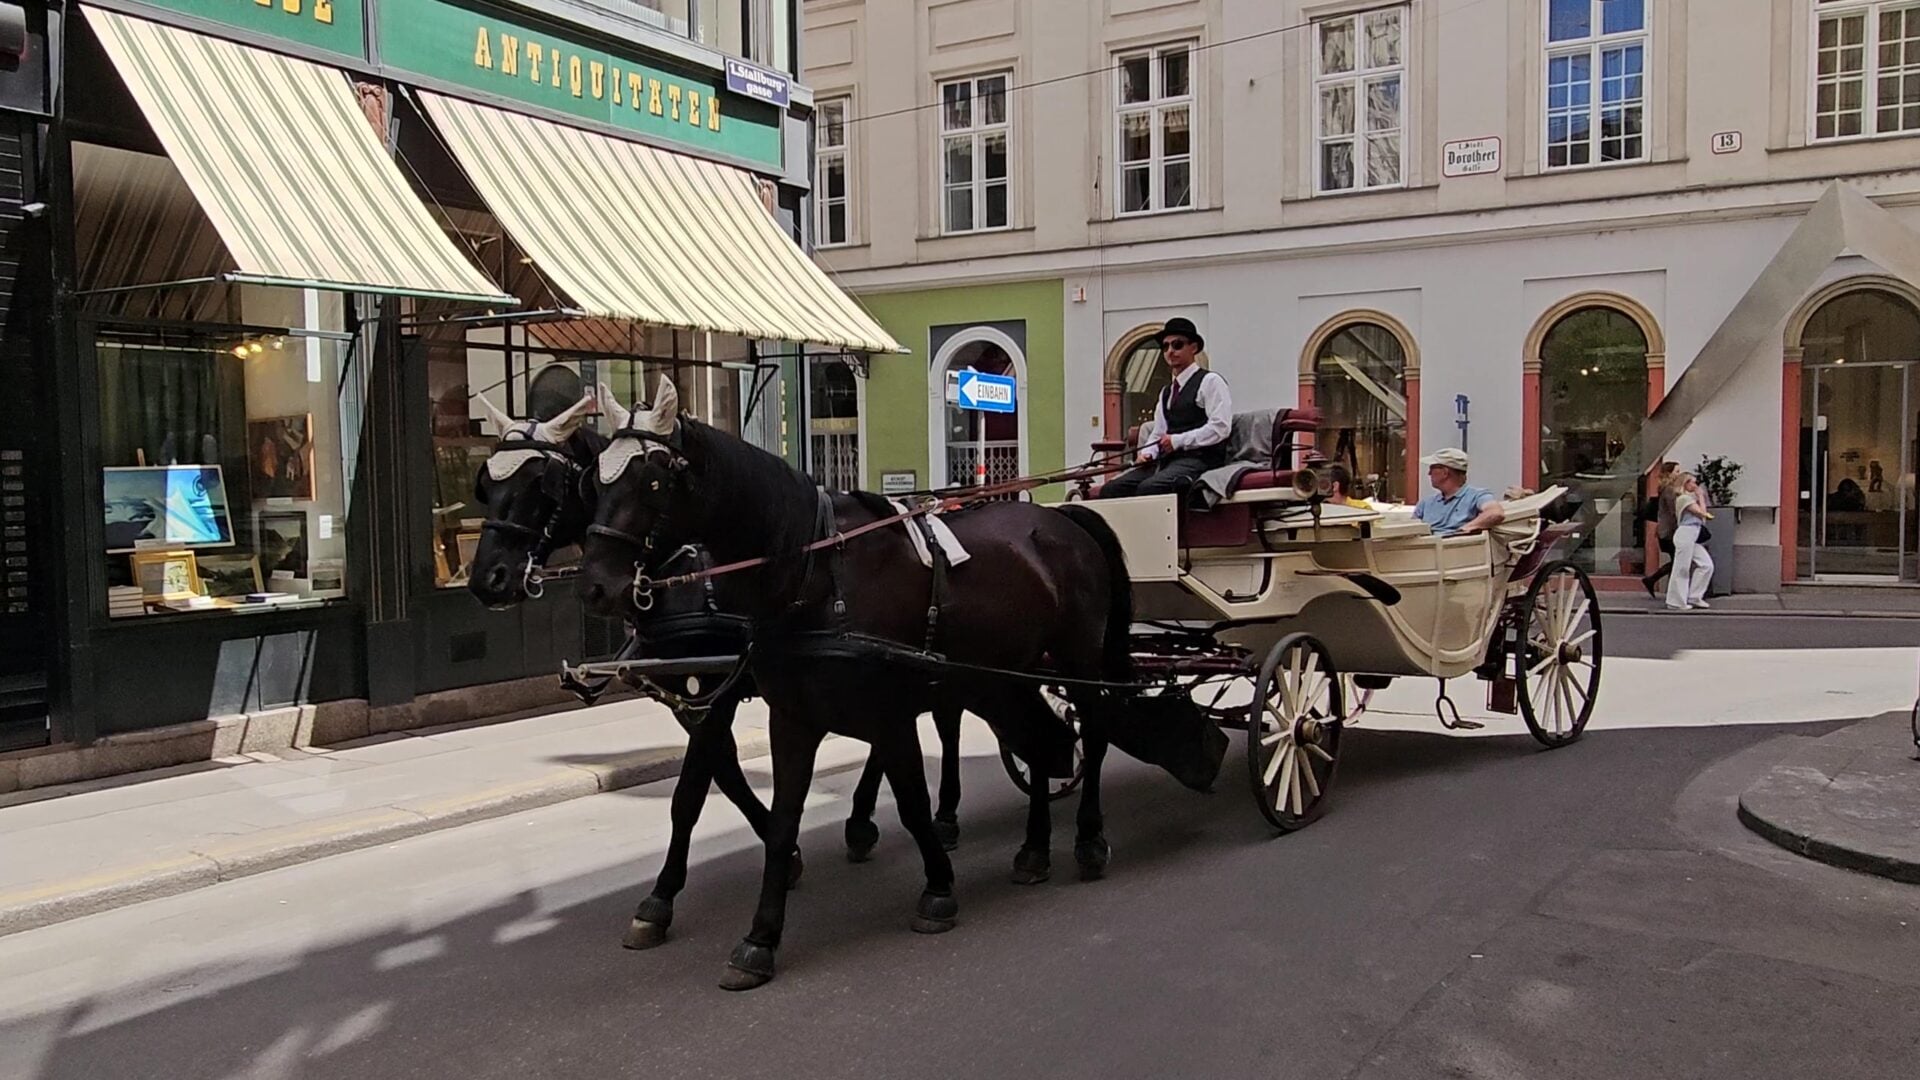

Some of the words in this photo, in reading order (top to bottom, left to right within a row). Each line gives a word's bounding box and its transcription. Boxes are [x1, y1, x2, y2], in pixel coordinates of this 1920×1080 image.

[746, 82, 773, 98] gasse
[1720, 134, 1734, 147] 13
[1448, 150, 1496, 165] Dorotheer
[977, 384, 1009, 401] EINBAHN
